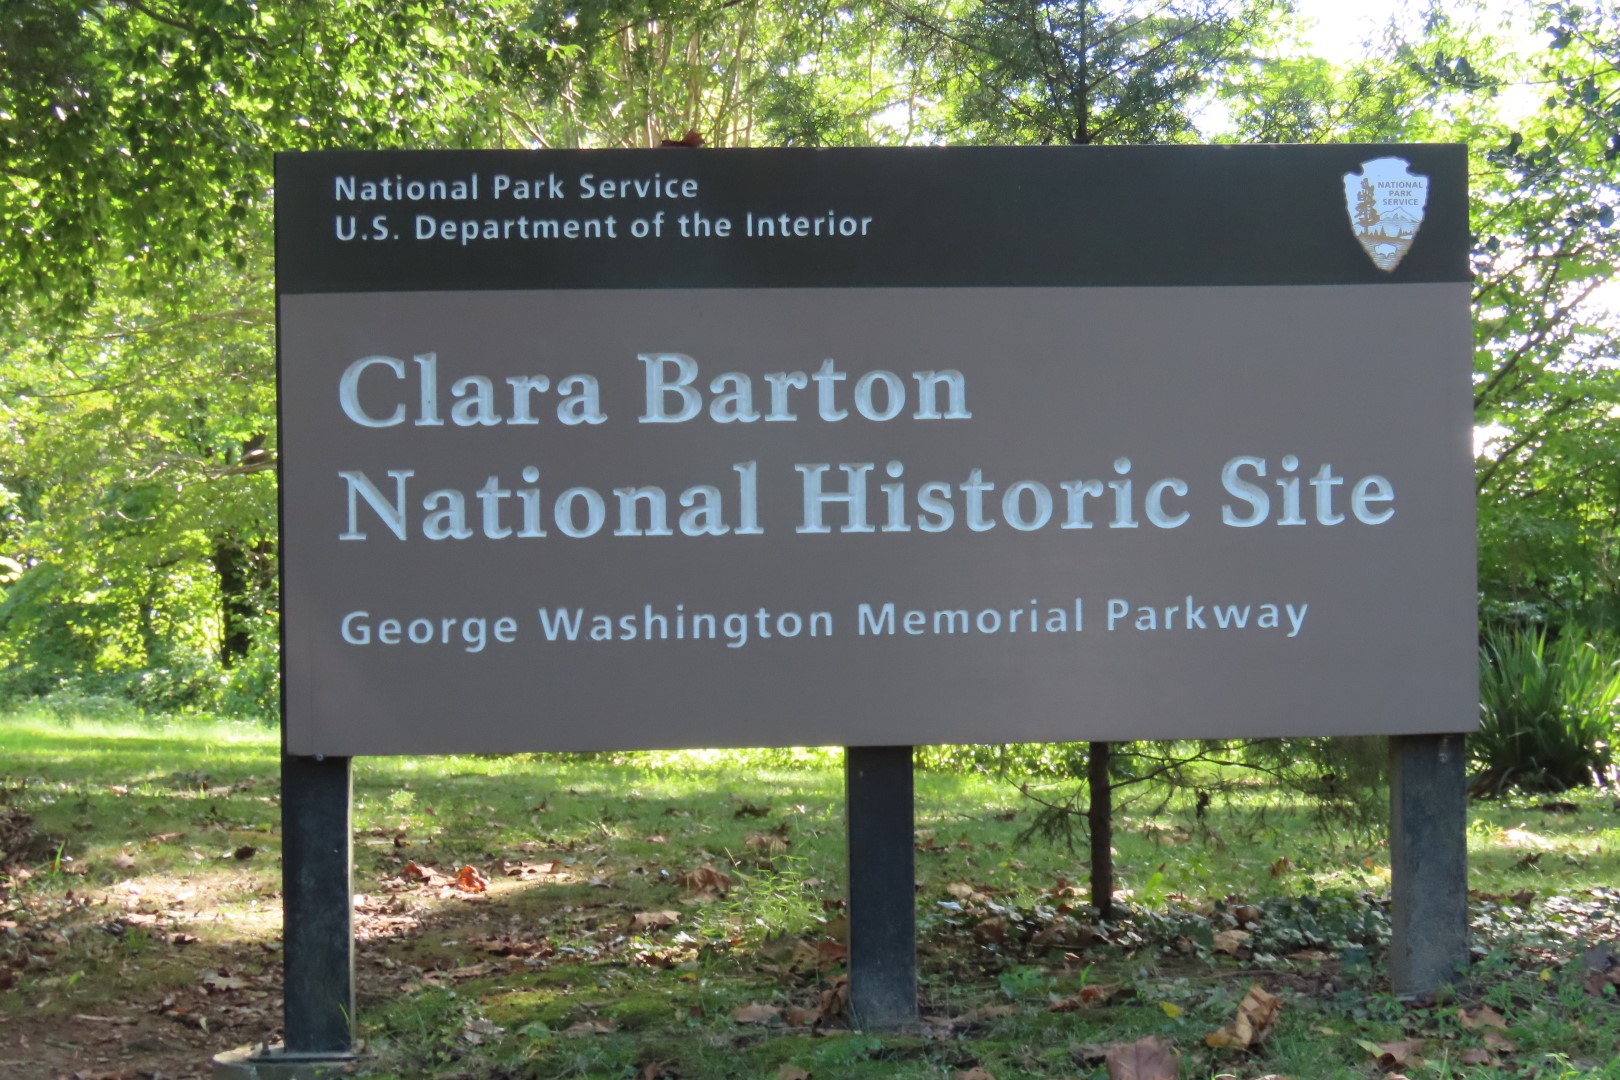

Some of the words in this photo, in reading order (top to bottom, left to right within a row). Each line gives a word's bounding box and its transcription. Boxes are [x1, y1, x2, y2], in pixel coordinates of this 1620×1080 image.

[335, 173, 478, 201] National
[494, 173, 565, 200] Park
[579, 173, 698, 199] Service
[1377, 181, 1424, 189] NATIONAL
[1382, 198, 1419, 206] SERVICE
[335, 215, 400, 241] U.S.
[415, 215, 617, 246] Department
[630, 211, 665, 239] of
[677, 212, 732, 238] the
[747, 210, 872, 237] Interior
[338, 352, 608, 428] Clara
[636, 352, 972, 424] Barton
[338, 461, 764, 541] National
[794, 459, 1191, 534] Historic
[1221, 454, 1395, 528] Site
[341, 610, 518, 653] George
[539, 603, 833, 648] Washington
[858, 597, 1083, 636] Memorial
[1107, 595, 1308, 638] Parkway
